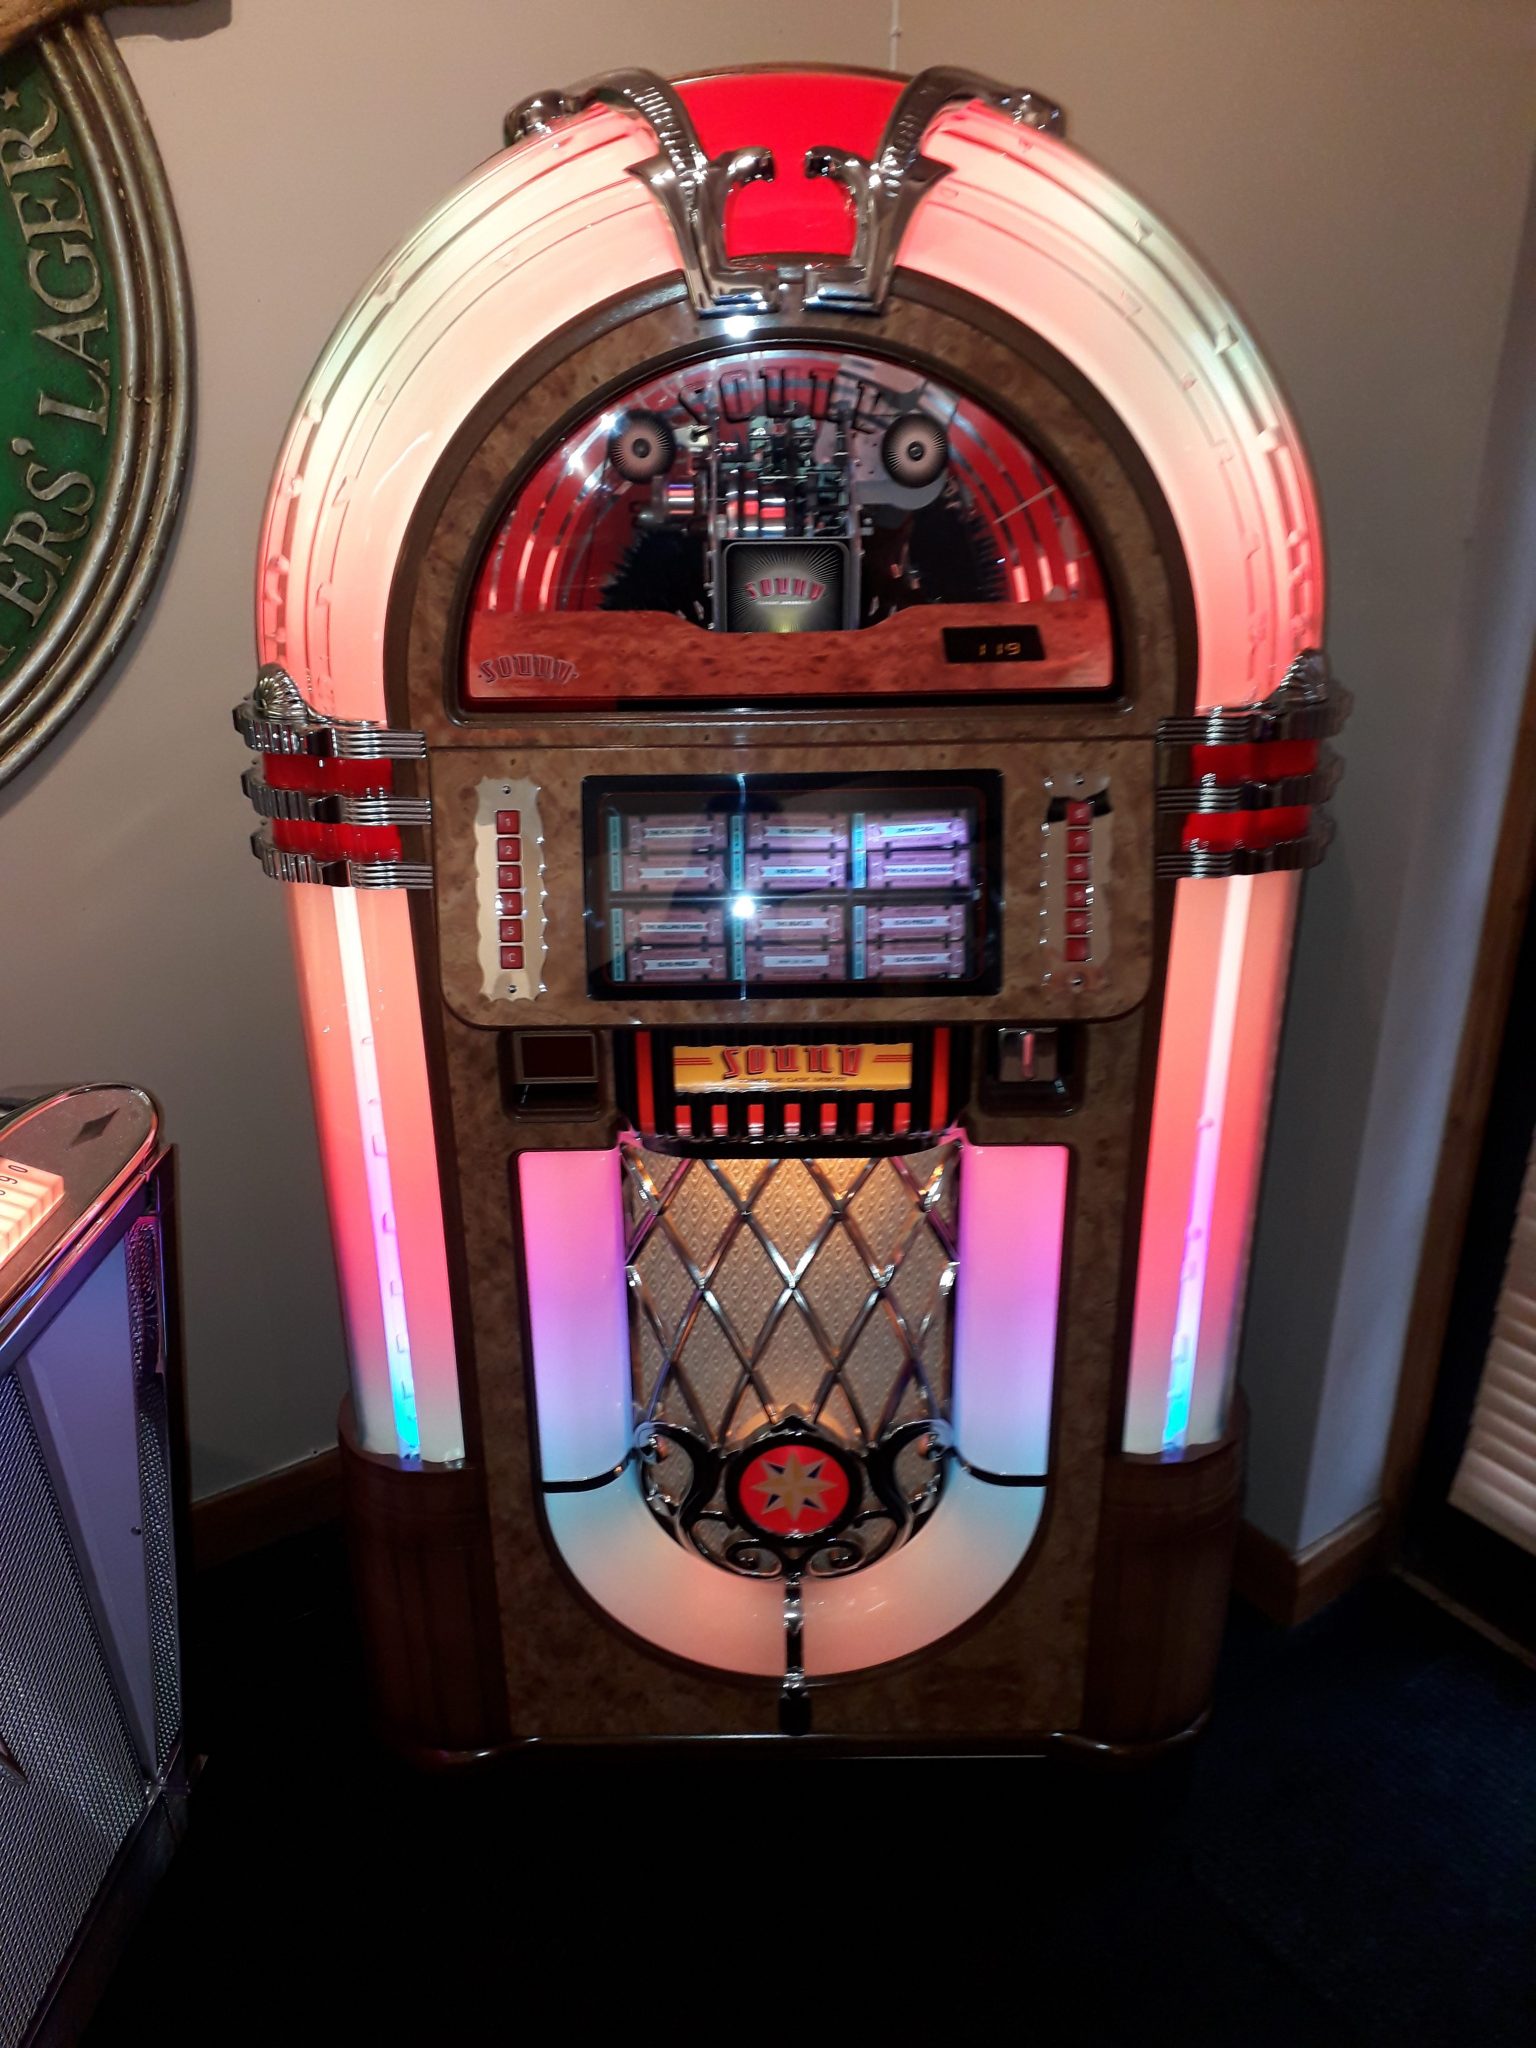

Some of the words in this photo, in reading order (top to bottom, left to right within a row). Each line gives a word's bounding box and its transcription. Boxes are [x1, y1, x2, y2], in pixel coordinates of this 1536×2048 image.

[1, 87, 109, 436] LAGER
[0, 437, 96, 666] ERS'
[744, 577, 827, 602] SOUND
[479, 654, 579, 685] SOUND
[505, 845, 513, 855] 2
[506, 872, 513, 882] 3
[507, 926, 515, 935] 5
[722, 1046, 865, 1079] SOUND
